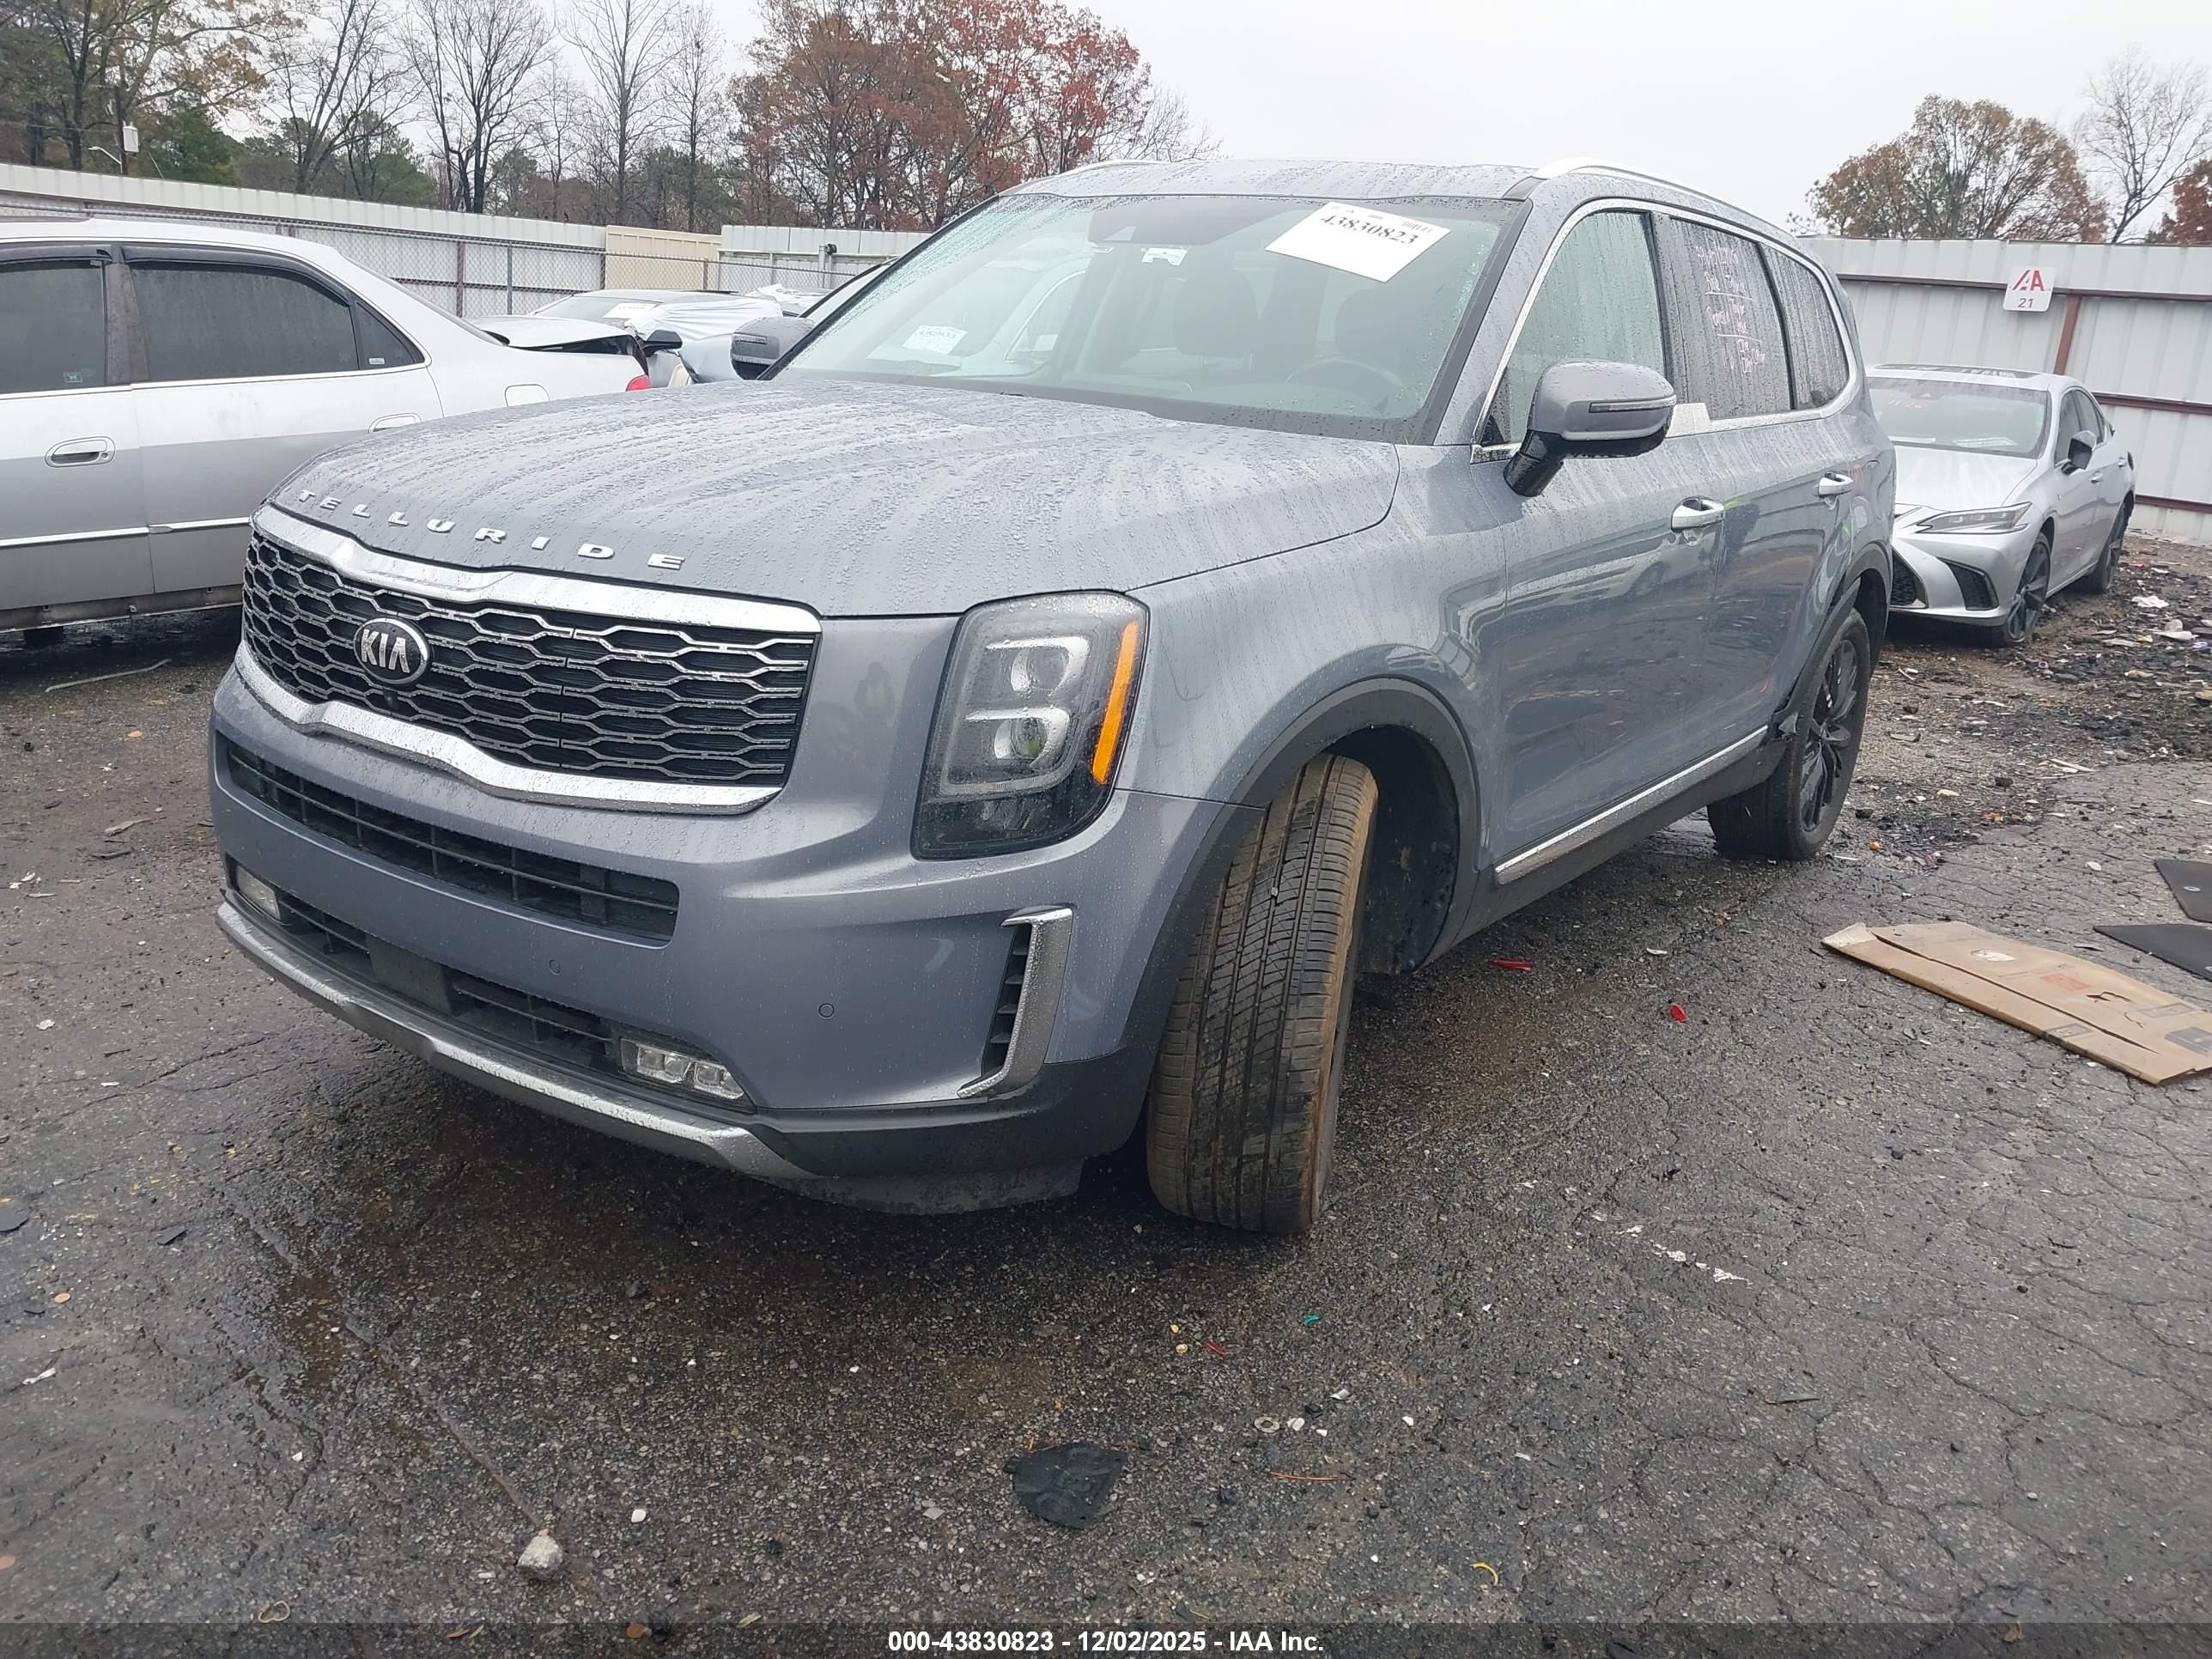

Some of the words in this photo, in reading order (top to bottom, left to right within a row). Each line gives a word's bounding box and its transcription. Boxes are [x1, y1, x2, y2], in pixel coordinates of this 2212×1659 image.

[1321, 215, 1419, 245] 43830823
[2018, 297, 2034, 309] 21
[299, 489, 686, 571] TELLURIDE
[360, 629, 412, 675] KIA
